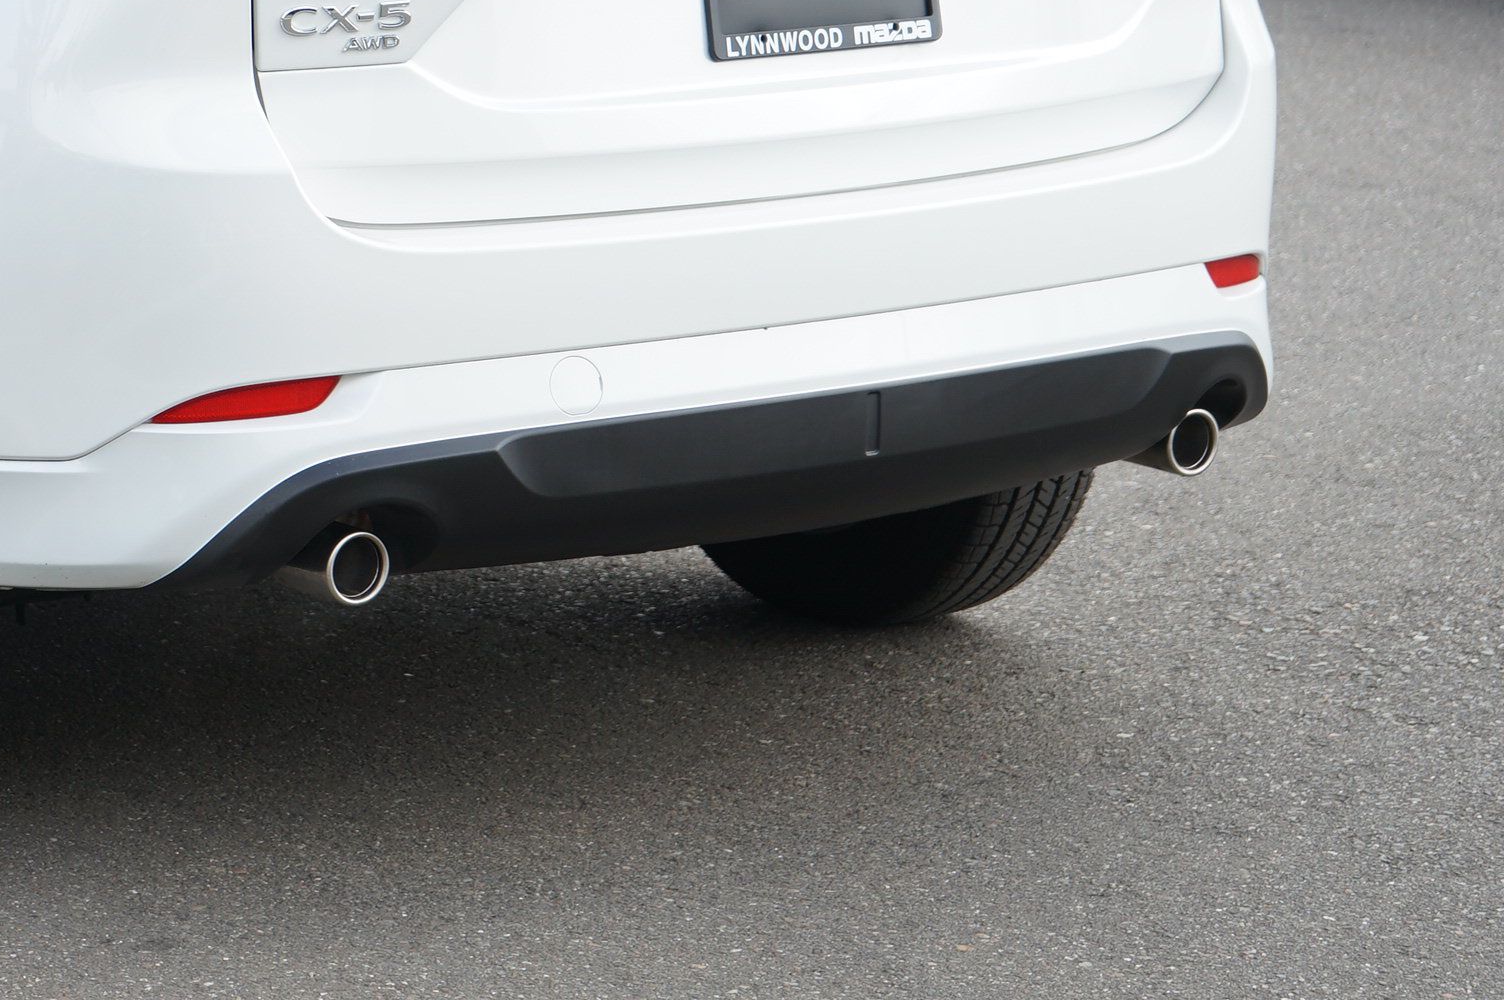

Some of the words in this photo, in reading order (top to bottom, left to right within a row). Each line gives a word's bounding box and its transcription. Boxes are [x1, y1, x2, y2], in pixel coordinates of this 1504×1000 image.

[280, 0, 412, 36] CX-5
[343, 34, 400, 53] AWD
[726, 27, 843, 58] LYNNWOOD
